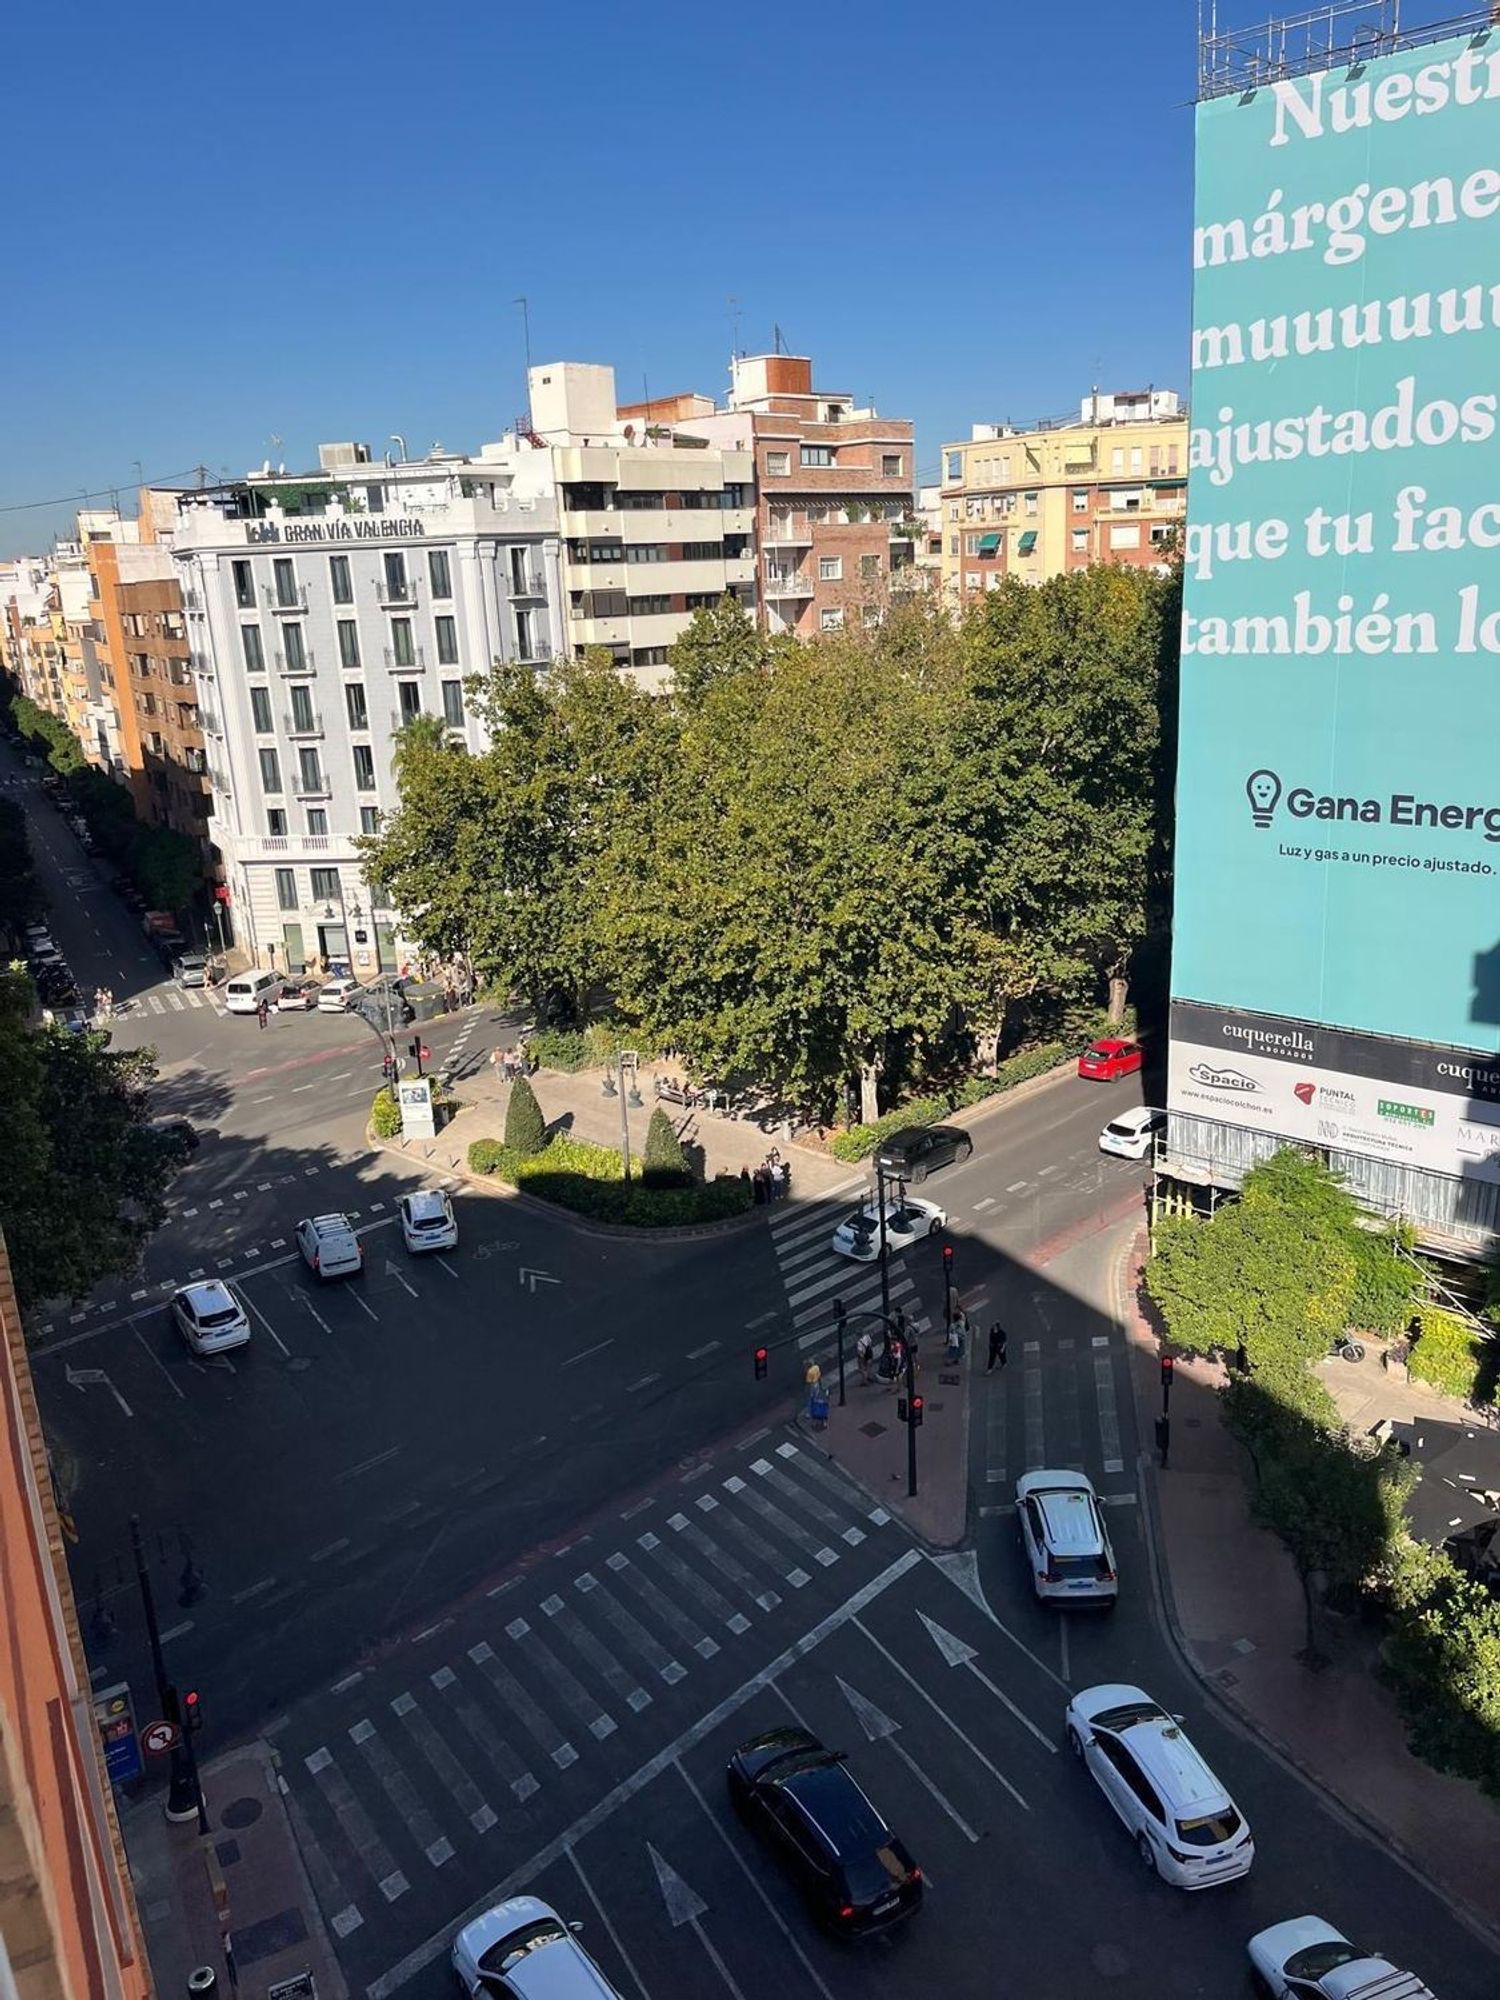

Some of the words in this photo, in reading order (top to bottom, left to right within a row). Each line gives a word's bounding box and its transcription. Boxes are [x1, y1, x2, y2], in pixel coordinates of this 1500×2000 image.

[1193, 169, 1500, 269] márgene
[1191, 283, 1500, 370] muuuuu
[1190, 375, 1498, 486] ajustados
[284, 524, 322, 542] GRAN
[326, 518, 353, 540] VÍA
[353, 518, 425, 538] VALENCIA
[1185, 518, 1289, 581] que
[1304, 506, 1374, 557] tu
[1392, 486, 1500, 552] fac
[1180, 589, 1439, 655] también
[1287, 787, 1381, 823] Gana
[1390, 794, 1500, 843] Energ
[1279, 843, 1302, 857] Luz
[1304, 848, 1312, 860] y
[1315, 849, 1339, 861] gas
[1341, 851, 1350, 861] a
[1352, 853, 1370, 863] un
[1372, 854, 1420, 868] precio
[1423, 857, 1497, 876] ajustado.
[1222, 1024, 1314, 1052] cuquerella
[1260, 1045, 1313, 1060] ABOGADOS
[1319, 1086, 1356, 1102] PUNTAL
